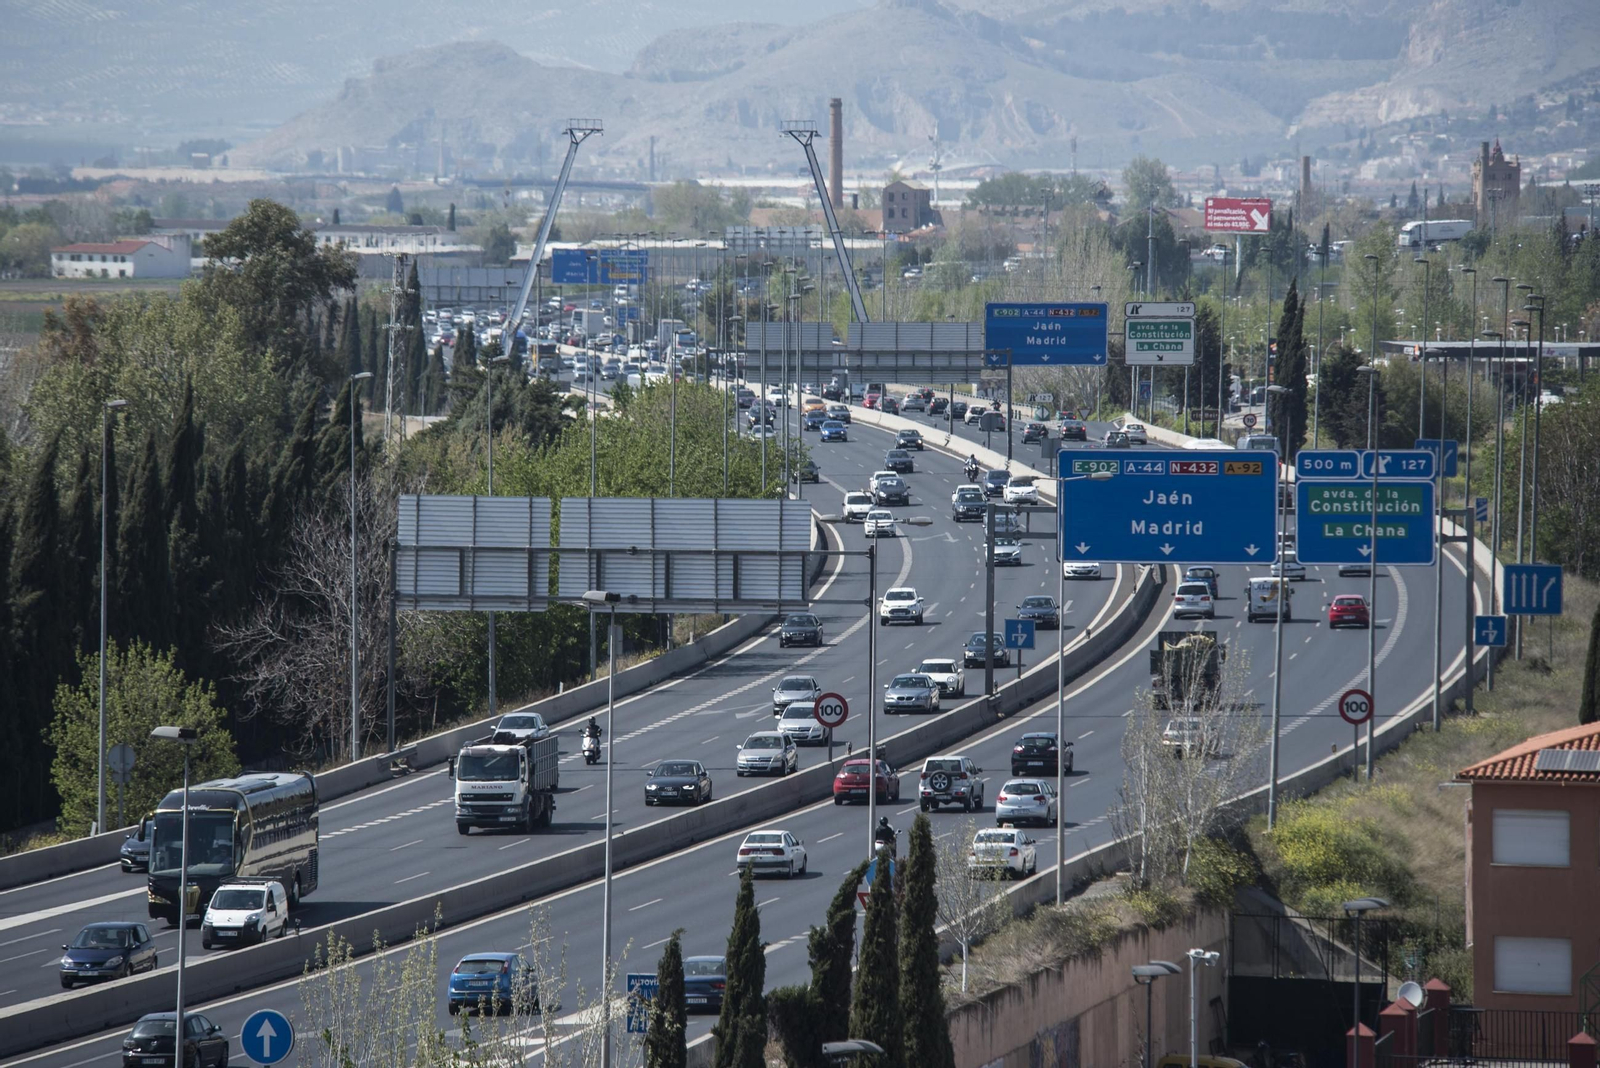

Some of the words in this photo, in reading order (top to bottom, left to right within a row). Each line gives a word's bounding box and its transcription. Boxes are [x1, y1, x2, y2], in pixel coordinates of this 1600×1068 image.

[1033, 322, 1061, 331] Jaén
[1026, 336, 1066, 345] Madrid
[1074, 461, 1118, 472] E-902
[1127, 462, 1163, 473] A-44
[1172, 462, 1217, 473] N-432
[1226, 463, 1261, 473] A-92
[1304, 459, 1334, 470] 500
[1341, 461, 1352, 470] m
[1402, 459, 1427, 470] 127
[1143, 490, 1193, 505] Jaén
[1323, 489, 1357, 498] avda.
[1387, 489, 1398, 499] la
[1311, 500, 1420, 512] Constitución
[1131, 520, 1204, 535] Madrid
[1324, 524, 1344, 536] La
[1353, 524, 1406, 537] Chana
[819, 704, 843, 716] 100
[1344, 701, 1369, 713] 100
